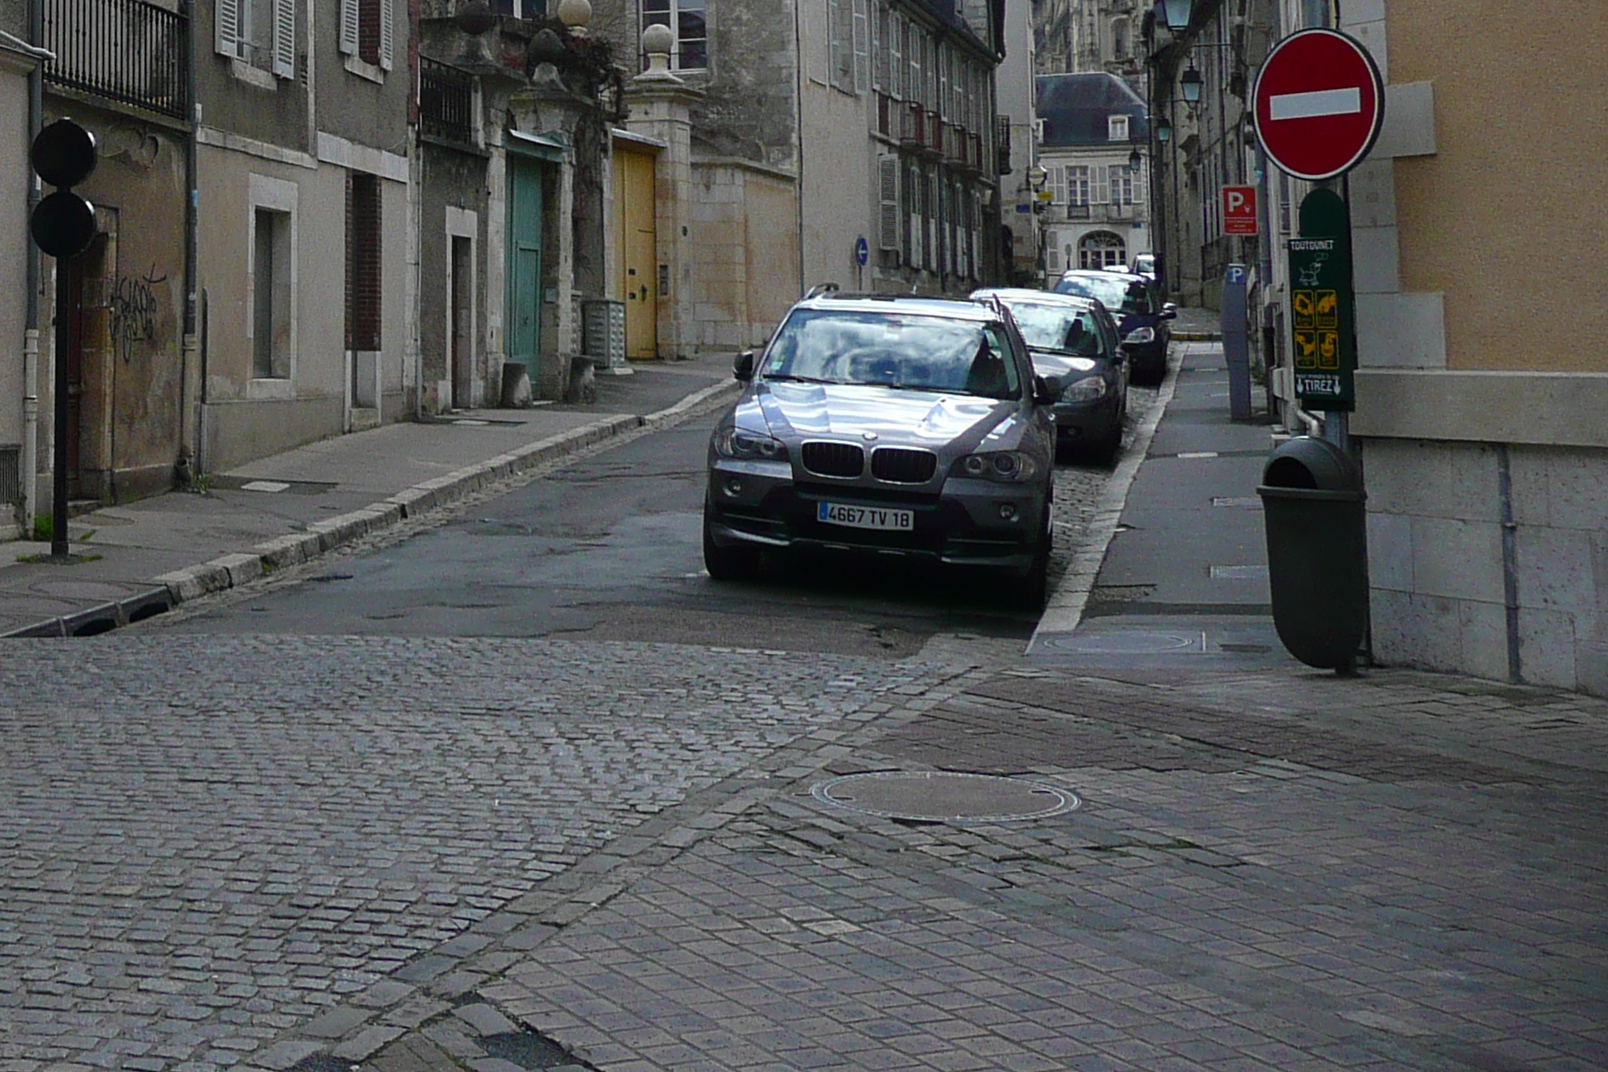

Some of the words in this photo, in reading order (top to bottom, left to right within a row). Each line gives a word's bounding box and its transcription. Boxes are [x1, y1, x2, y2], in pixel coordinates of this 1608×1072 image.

[1228, 191, 1245, 213] P
[1290, 240, 1334, 251] TOUTOUNET
[1231, 266, 1244, 283] P
[1304, 379, 1333, 392] TIREZ
[828, 507, 865, 524] 4667
[869, 510, 887, 526] TV
[893, 513, 910, 528] 18
